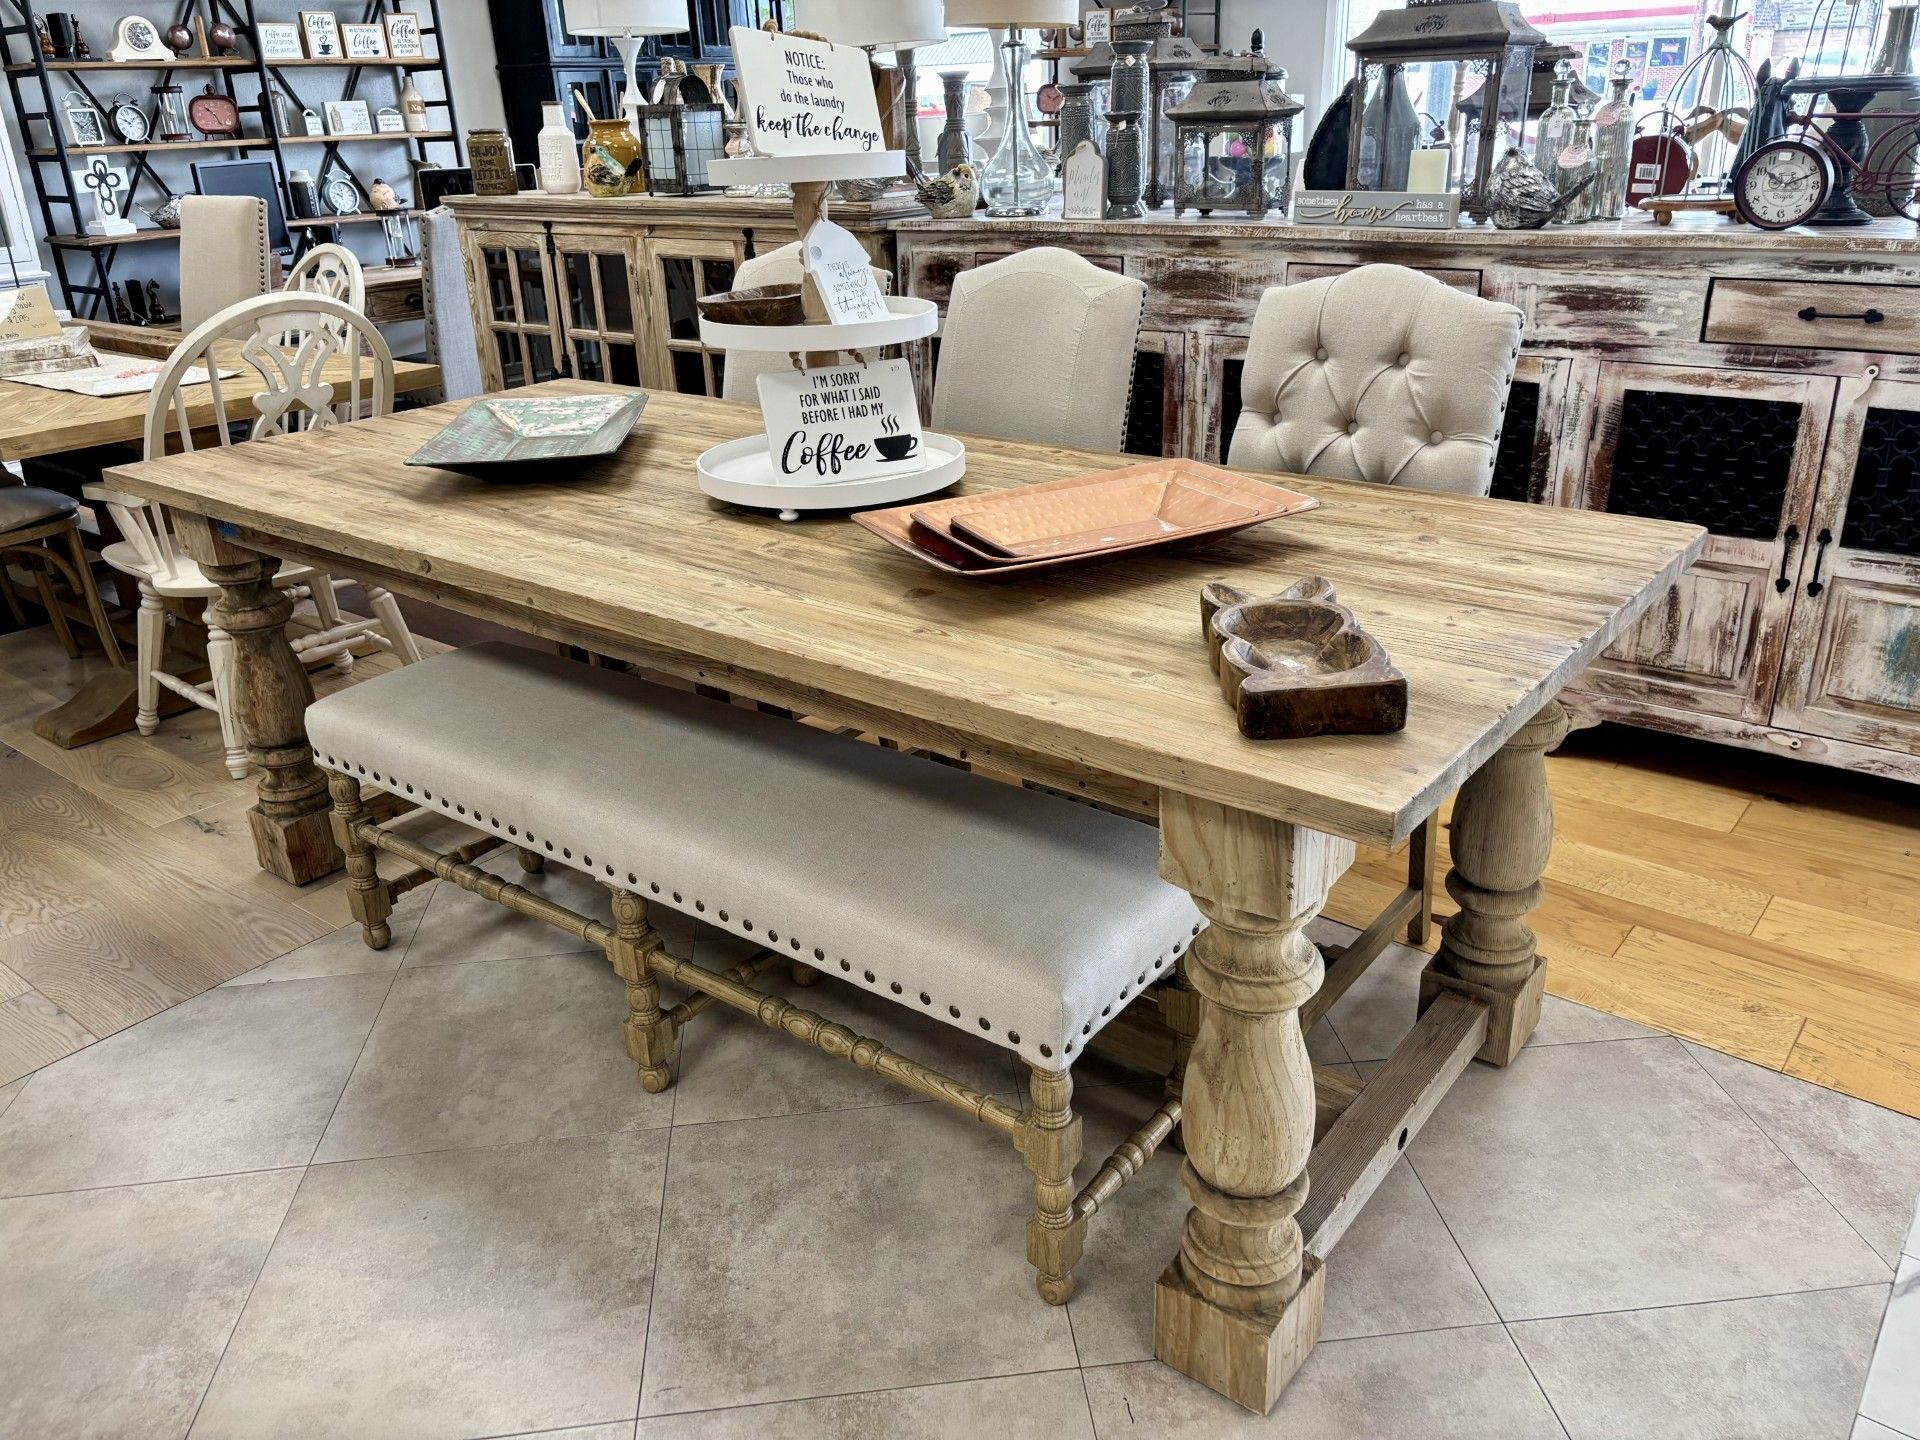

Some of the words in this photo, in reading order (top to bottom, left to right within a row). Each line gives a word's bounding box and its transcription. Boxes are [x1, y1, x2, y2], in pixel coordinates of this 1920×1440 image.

[308, 15, 332, 29] Coffee
[391, 23, 415, 38] Coffee
[354, 33, 376, 48] Coffee
[784, 50, 826, 71] NOTICE:
[786, 70, 813, 86] Those
[815, 76, 833, 89] who
[780, 89, 792, 103] do
[794, 92, 809, 105] the
[811, 93, 845, 113] laundry
[756, 105, 792, 138] keep
[792, 112, 822, 137] the
[824, 116, 879, 151] change
[1297, 197, 1339, 206] sometimes
[1299, 194, 1414, 223] home
[1415, 199, 1433, 209] has
[1394, 211, 1445, 223] heartbeat
[812, 374, 828, 388] I'M
[831, 371, 861, 387] SORRY
[800, 393, 819, 408] FOR
[820, 389, 849, 404] WHAT
[852, 389, 857, 401] I
[859, 386, 881, 400] SAID
[802, 408, 839, 425] BEFORE
[842, 408, 846, 420] I
[849, 403, 868, 418] HAD
[871, 402, 885, 416] MY
[781, 430, 872, 476] Coffee
